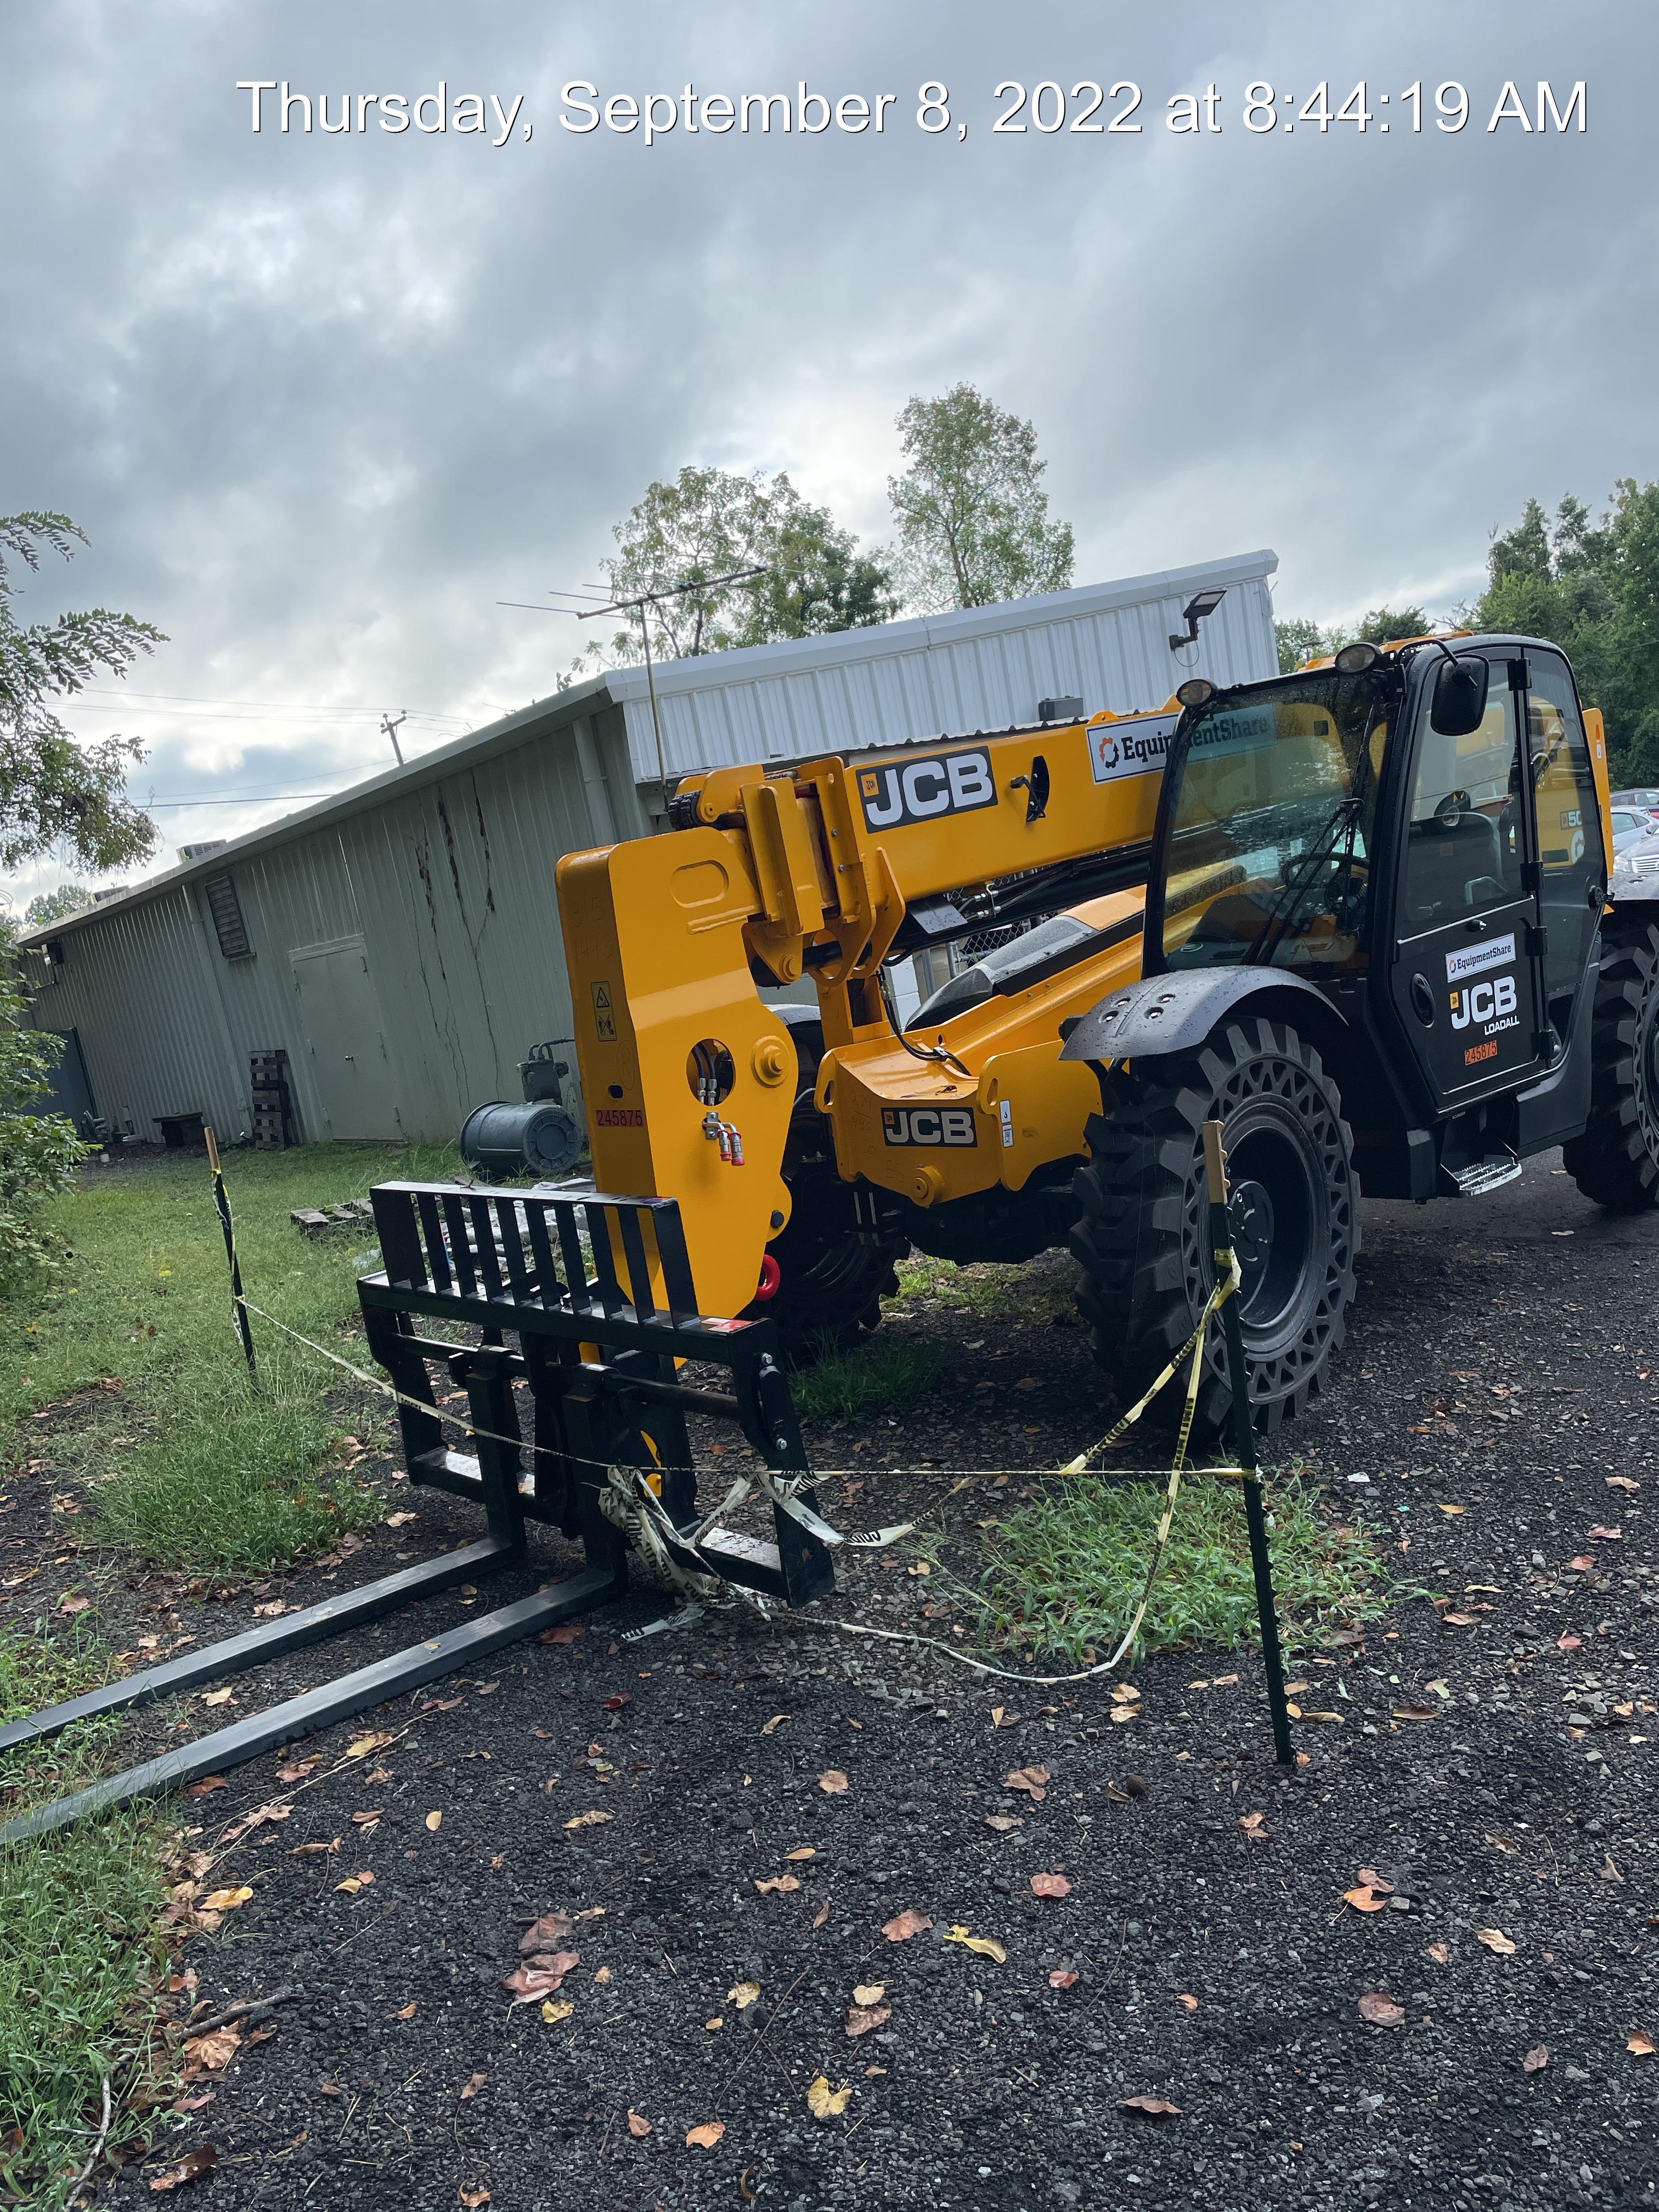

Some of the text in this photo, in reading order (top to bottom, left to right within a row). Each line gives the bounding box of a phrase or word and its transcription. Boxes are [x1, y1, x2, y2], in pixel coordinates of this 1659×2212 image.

[1121, 716, 1268, 763] EquientShare
[866, 753, 993, 826] JCB
[1457, 944, 1511, 970] EquipmentShare
[1451, 975, 1517, 1030] JCB
[1484, 1015, 1520, 1036] LOADALL
[1466, 1042, 1497, 1064] 245875
[596, 1109, 643, 1126] 245875
[885, 1110, 974, 1143] JCB
